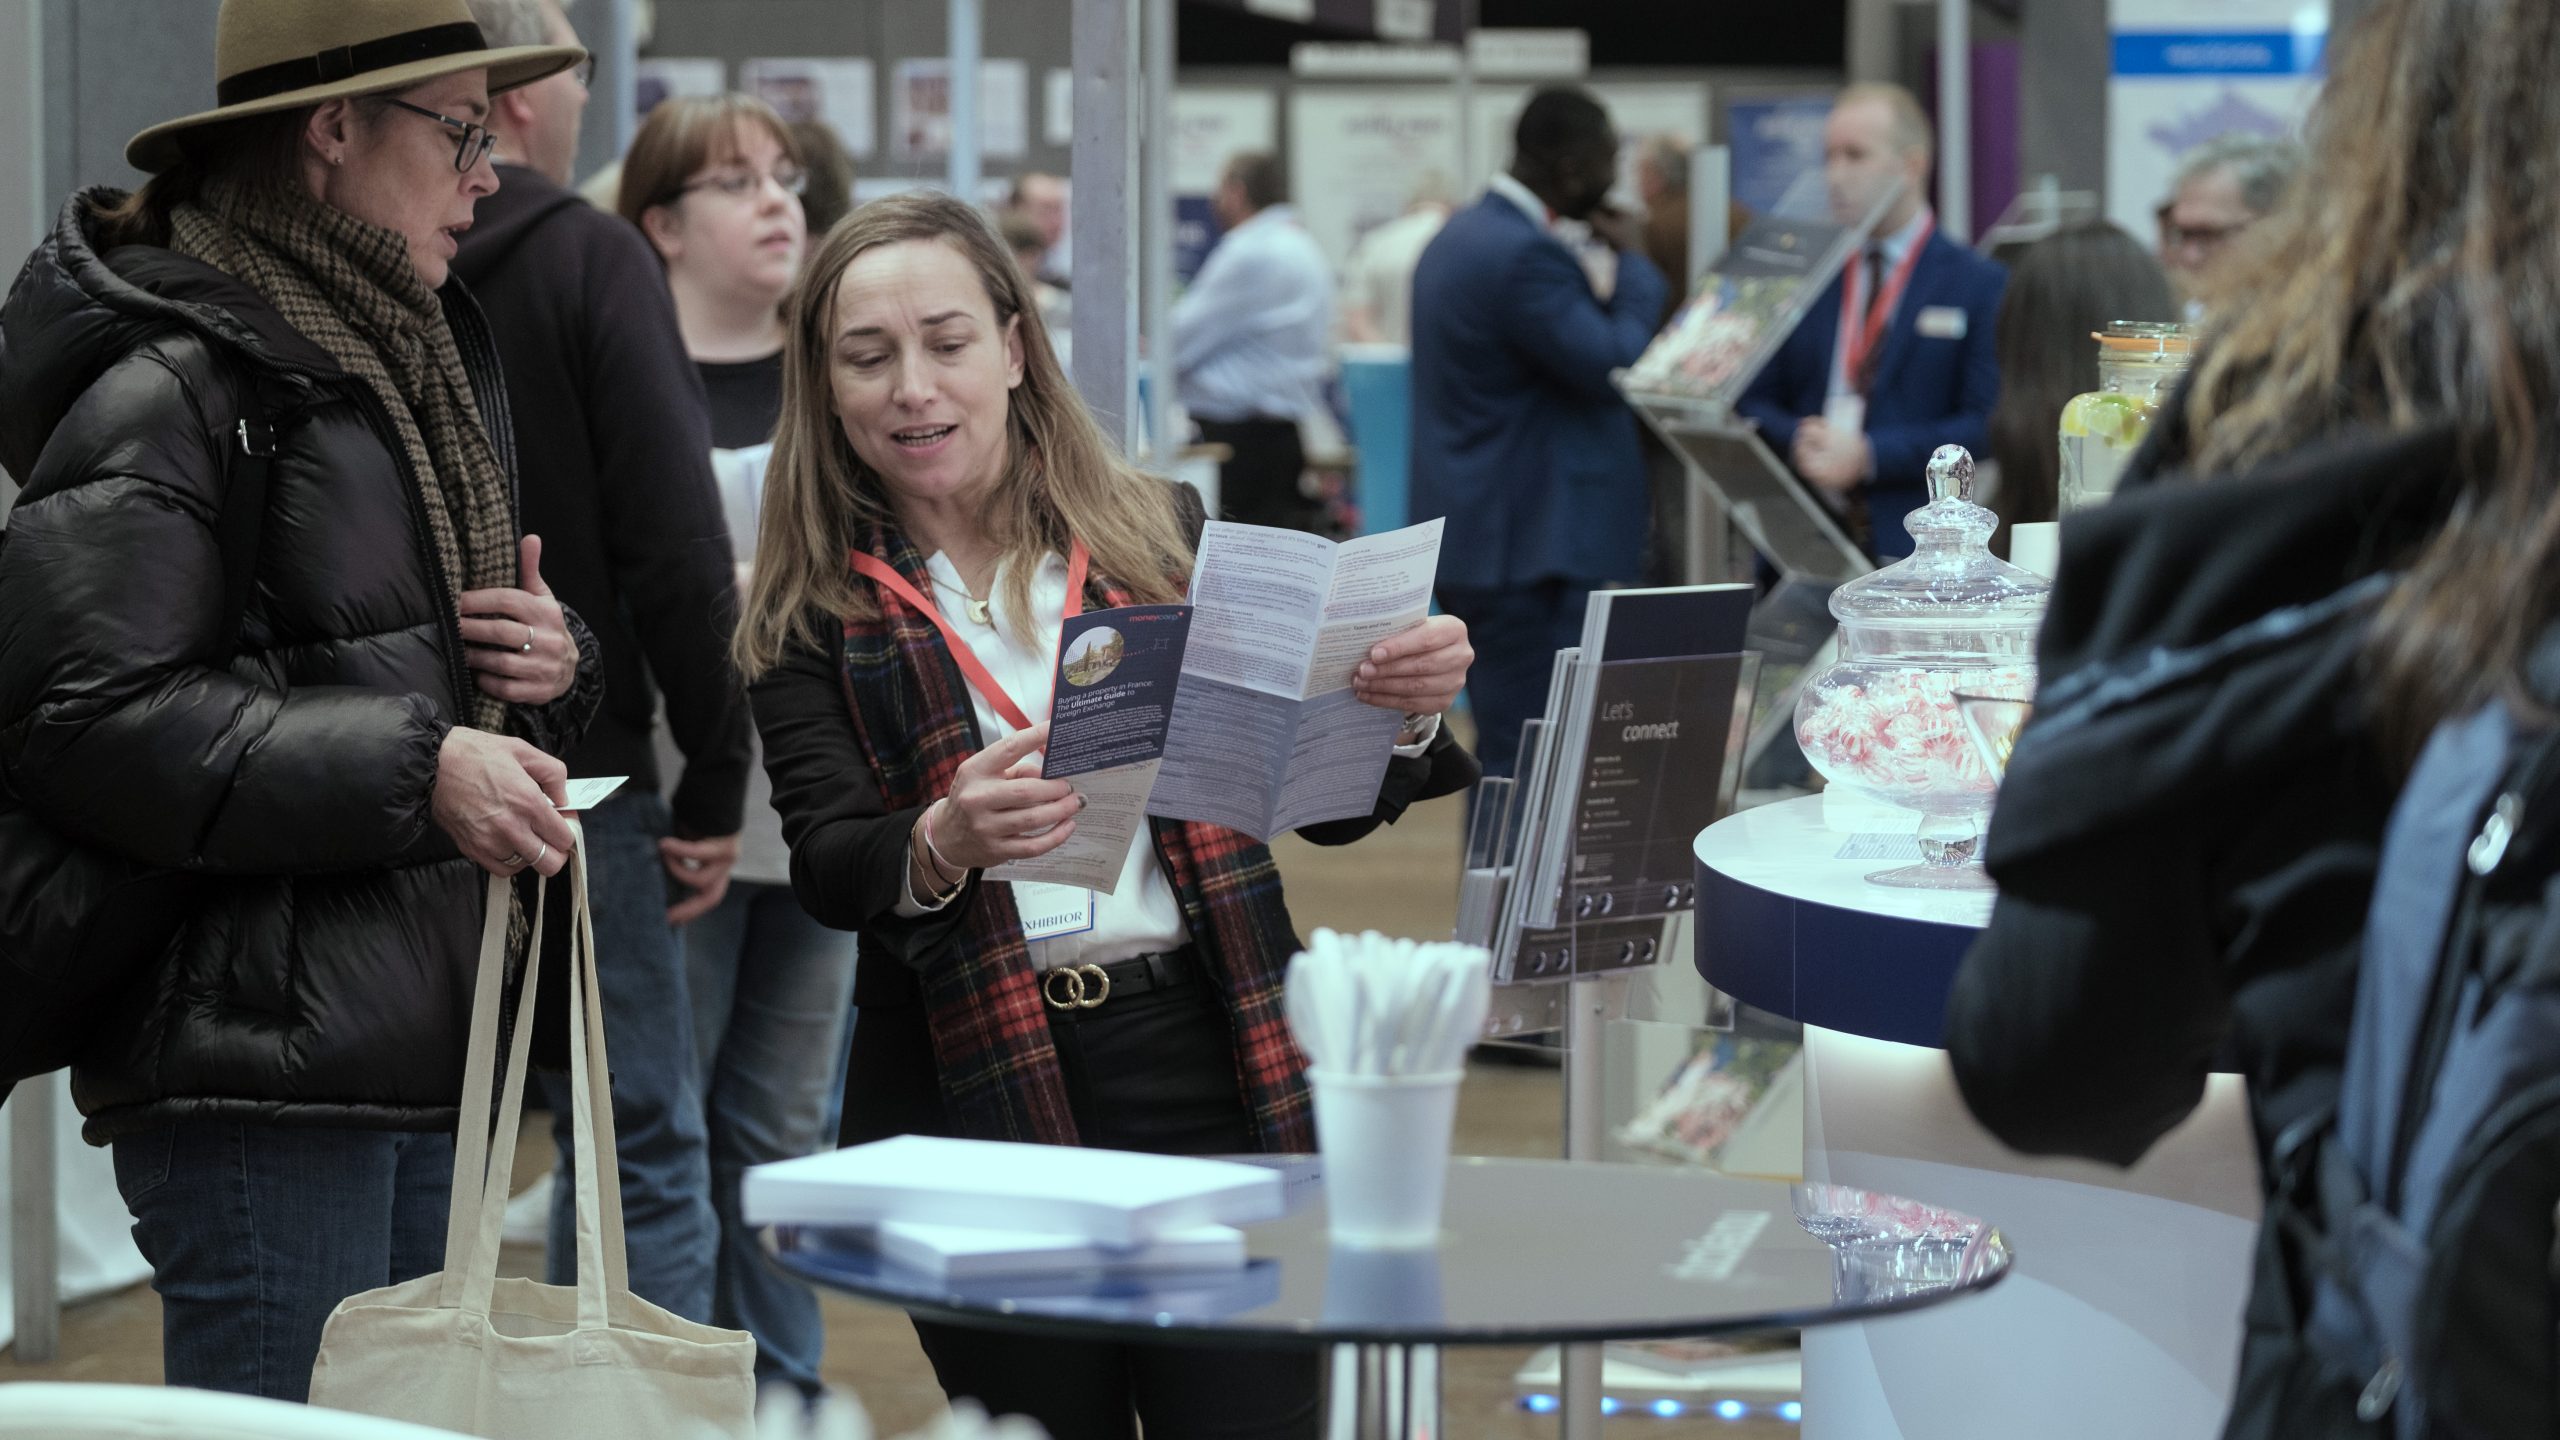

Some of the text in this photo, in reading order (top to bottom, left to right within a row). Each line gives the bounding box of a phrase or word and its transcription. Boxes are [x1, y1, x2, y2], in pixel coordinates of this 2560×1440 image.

[1057, 694, 1081, 705] Buying
[1087, 685, 1118, 698] property
[1127, 680, 1154, 690] France:
[1057, 703, 1070, 713] The
[1071, 696, 1102, 709] Ultimate
[1103, 690, 1126, 701] Guide
[1055, 700, 1116, 720] Foreign Exchange
[1622, 720, 1680, 742] connect
[1024, 911, 1083, 930] XHIBITOR
